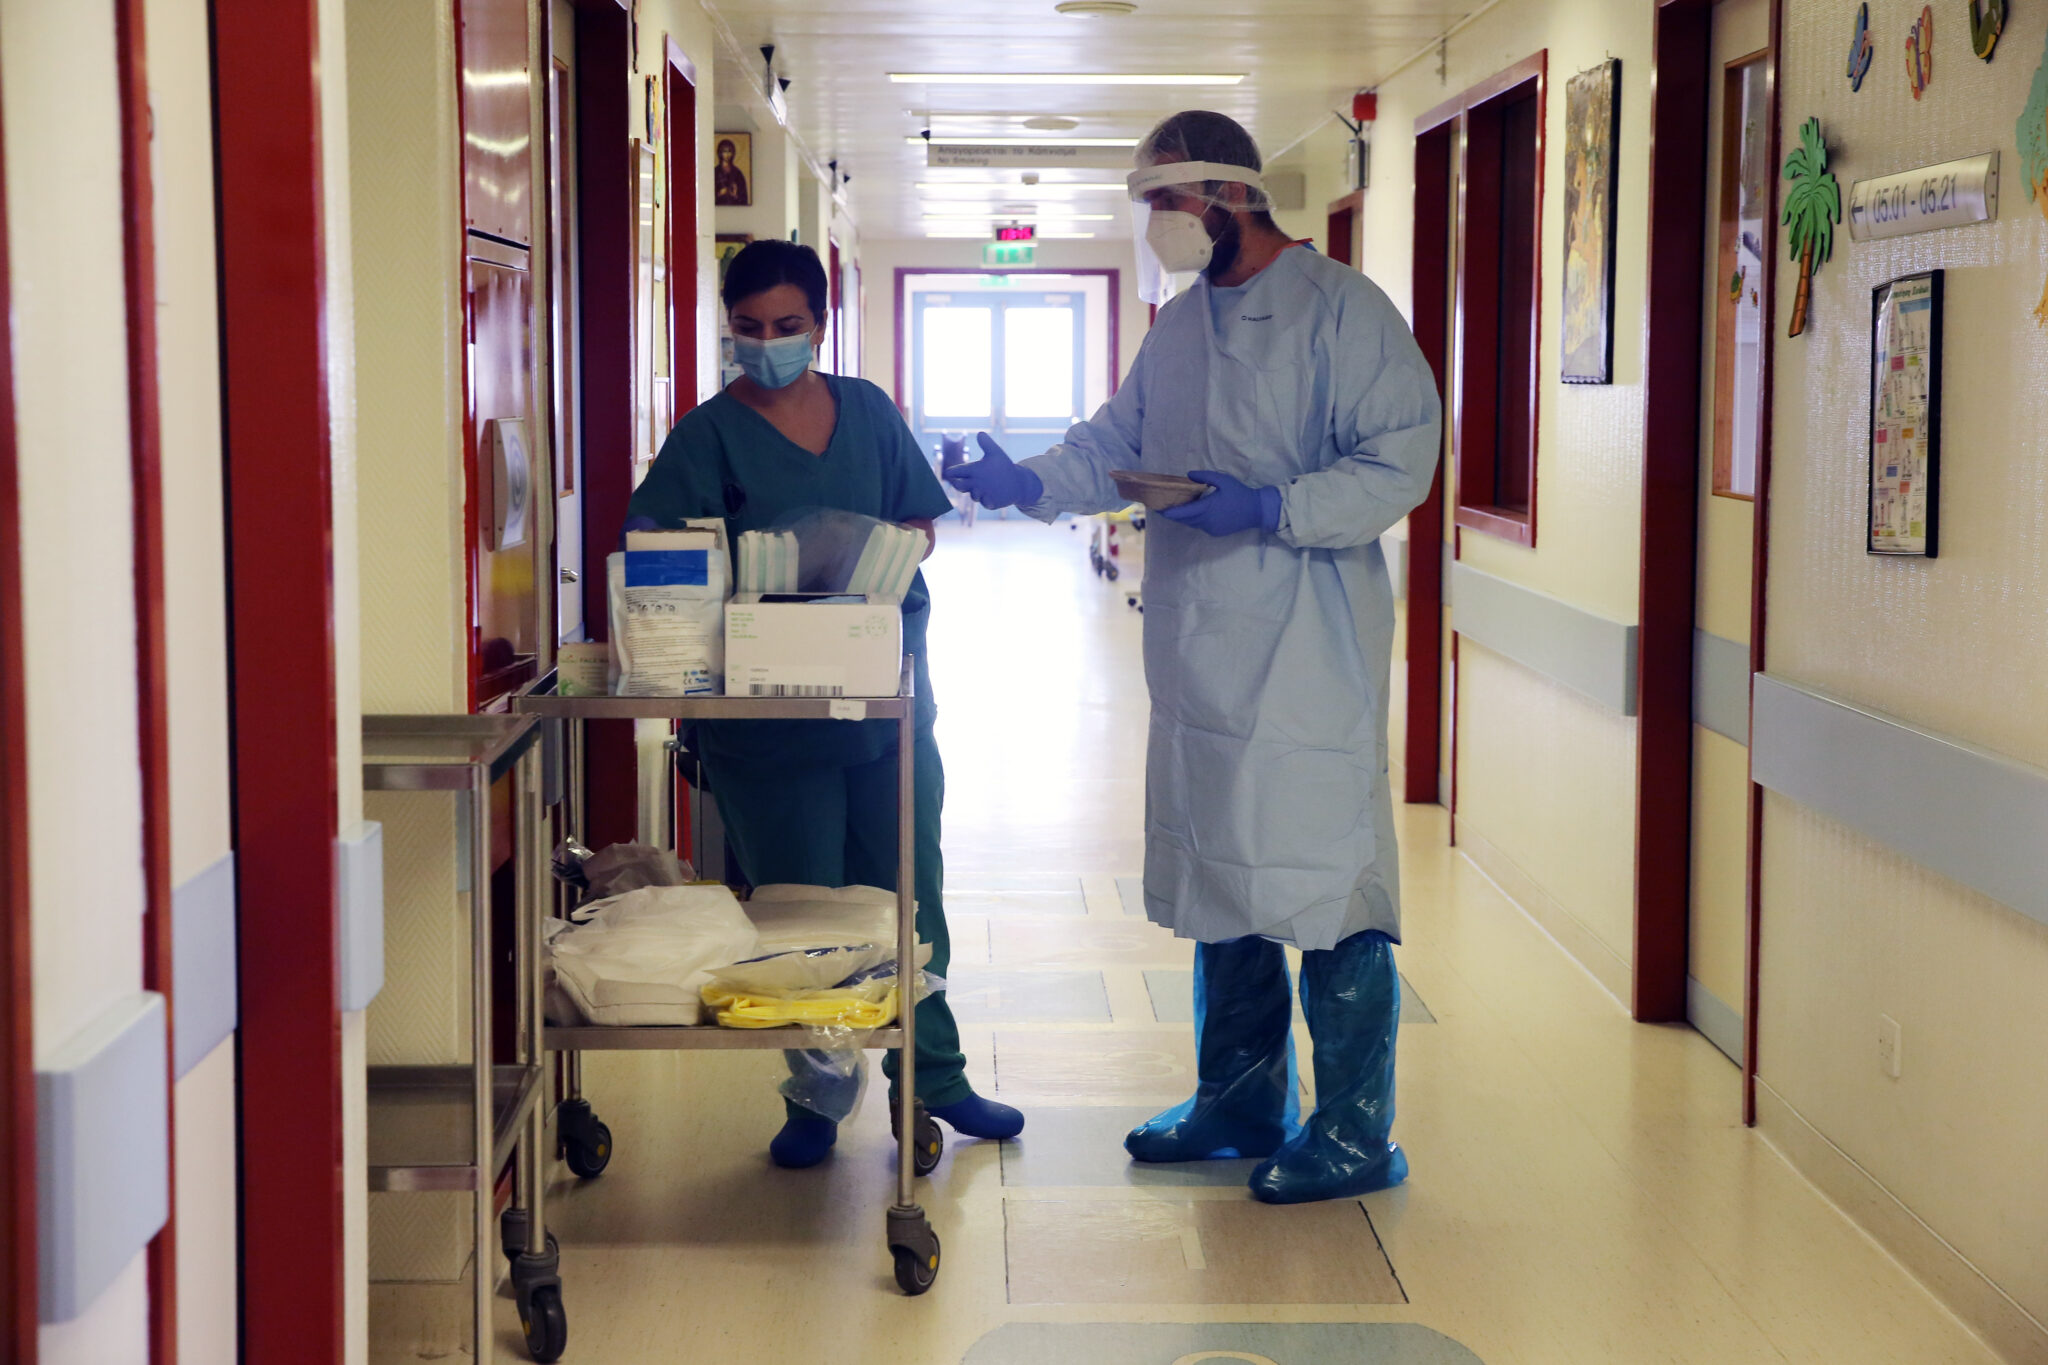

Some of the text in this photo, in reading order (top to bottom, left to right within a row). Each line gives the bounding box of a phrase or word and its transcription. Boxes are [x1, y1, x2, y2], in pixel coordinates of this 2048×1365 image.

[952, 156, 989, 166] Smoking
[1873, 183, 1908, 224] 05.01
[1919, 173, 1958, 216] 05.21
